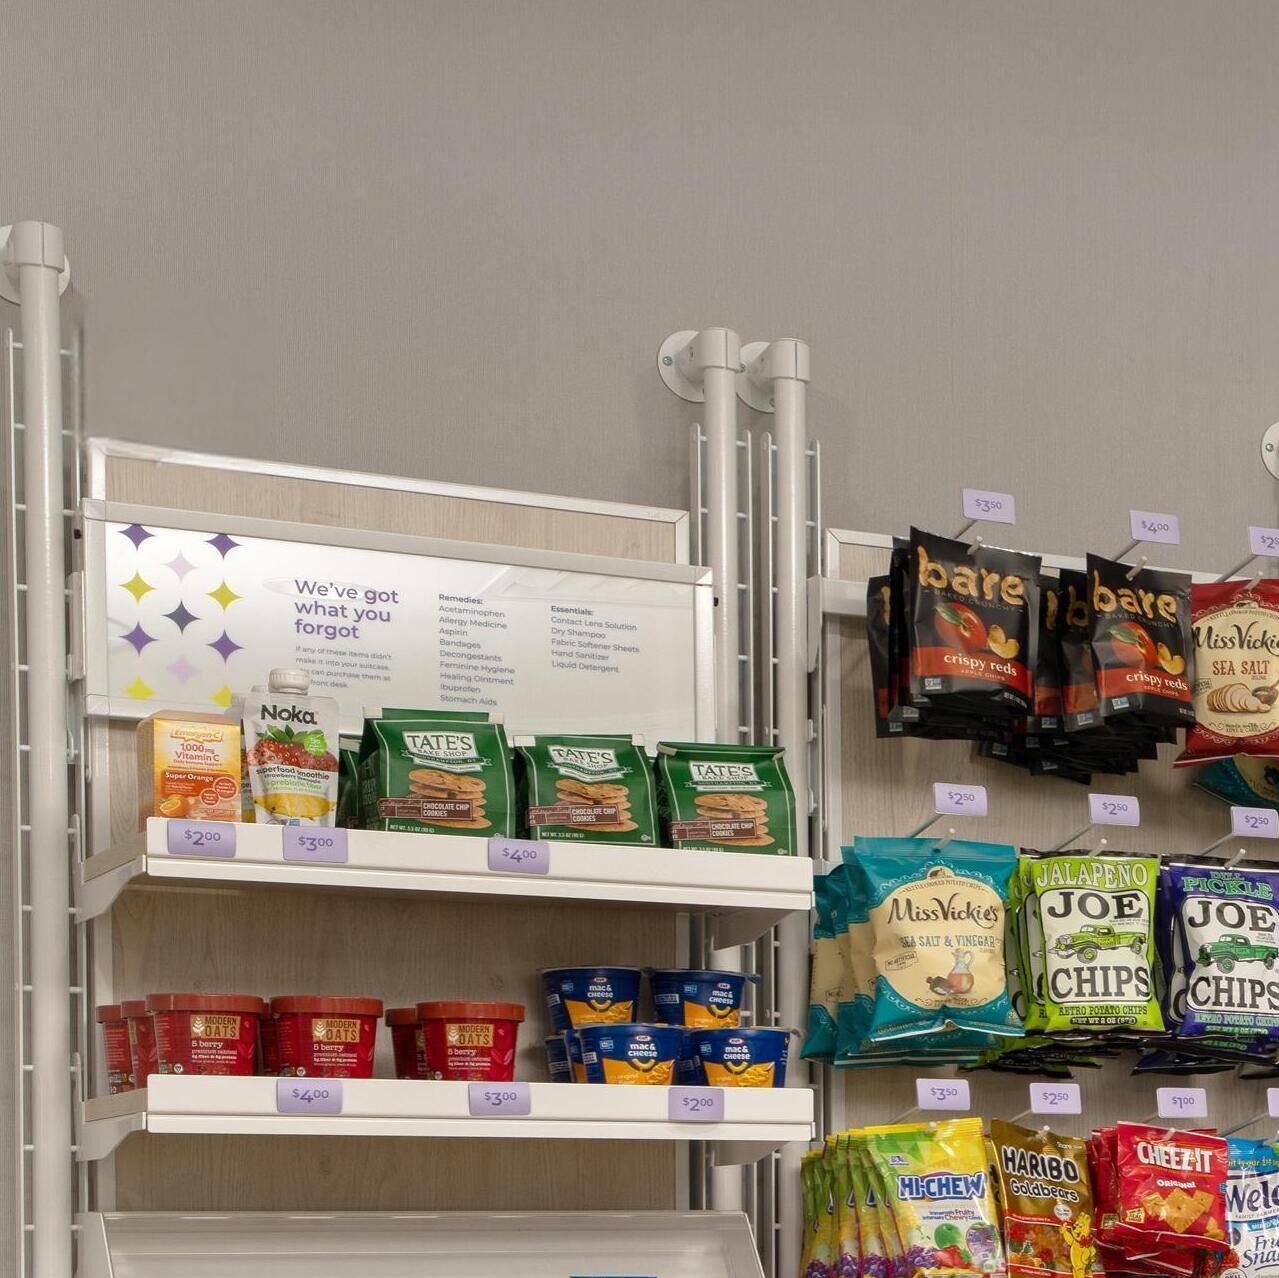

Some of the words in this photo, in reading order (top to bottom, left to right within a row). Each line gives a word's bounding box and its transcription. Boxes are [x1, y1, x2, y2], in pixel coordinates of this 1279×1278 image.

[917, 545, 1025, 605] bare
[295, 579, 358, 599] We've
[364, 589, 399, 605] got
[438, 593, 483, 605] Remedies:
[1092, 568, 1178, 623] bare
[295, 601, 347, 619] what
[353, 606, 391, 624] you
[439, 606, 505, 618] Acetaminophen
[551, 605, 594, 616] Essentials:
[295, 619, 360, 640] forgot
[439, 616, 468, 628] Allergy
[470, 619, 508, 630] Medicine
[551, 616, 581, 627] Contact
[583, 619, 603, 629] Lens
[604, 621, 637, 632] Solution
[439, 628, 468, 638] Aspirin
[551, 627, 566, 637] Dry
[568, 629, 606, 640] Shampoo
[439, 639, 481, 650] Bandages
[551, 638, 576, 648] Fabric
[578, 639, 611, 651] Softener
[613, 643, 640, 654] Sheets
[439, 650, 502, 662] Decongestants
[551, 649, 570, 658] Hand
[572, 651, 609, 661] Sanitizer
[440, 661, 478, 672] Feminine
[479, 664, 515, 676] Hygiene
[552, 660, 574, 671] Liquid
[577, 662, 619, 674] Detergent
[944, 653, 987, 671] crispy
[989, 660, 1018, 676] reds
[1212, 661, 1235, 676] SEA
[1241, 660, 1270, 675] SALT
[440, 672, 472, 684] Healing
[474, 675, 514, 685] Ointment
[440, 683, 481, 694] Ibuprofen
[260, 704, 317, 725] Noka
[407, 734, 473, 752] TATE'S
[552, 747, 614, 765] TATE'S
[165, 772, 185, 781] Super
[187, 773, 214, 782] Orange
[423, 803, 454, 811] CHOCOLATE
[456, 803, 470, 811] CHIP
[423, 809, 448, 818] COOKIES
[1036, 861, 1148, 888] JALAPEÑO
[1183, 877, 1274, 900] PICKLE
[1047, 892, 1143, 920] JOE
[1188, 901, 1276, 932] JOE
[902, 937, 915, 948] SEA
[918, 936, 941, 947] SALT
[944, 937, 953, 947] &
[956, 935, 995, 948] VINEGAR
[1051, 966, 1151, 998] CHIPS
[205, 1016, 237, 1026] MODERN
[204, 1026, 236, 1038] OATS
[1002, 1147, 1079, 1183] HARIBO
[1136, 1141, 1213, 1174] CHEEZ-IT
[898, 1173, 986, 1200] HI-CHEW
[1010, 1178, 1079, 1201] Goldbears
